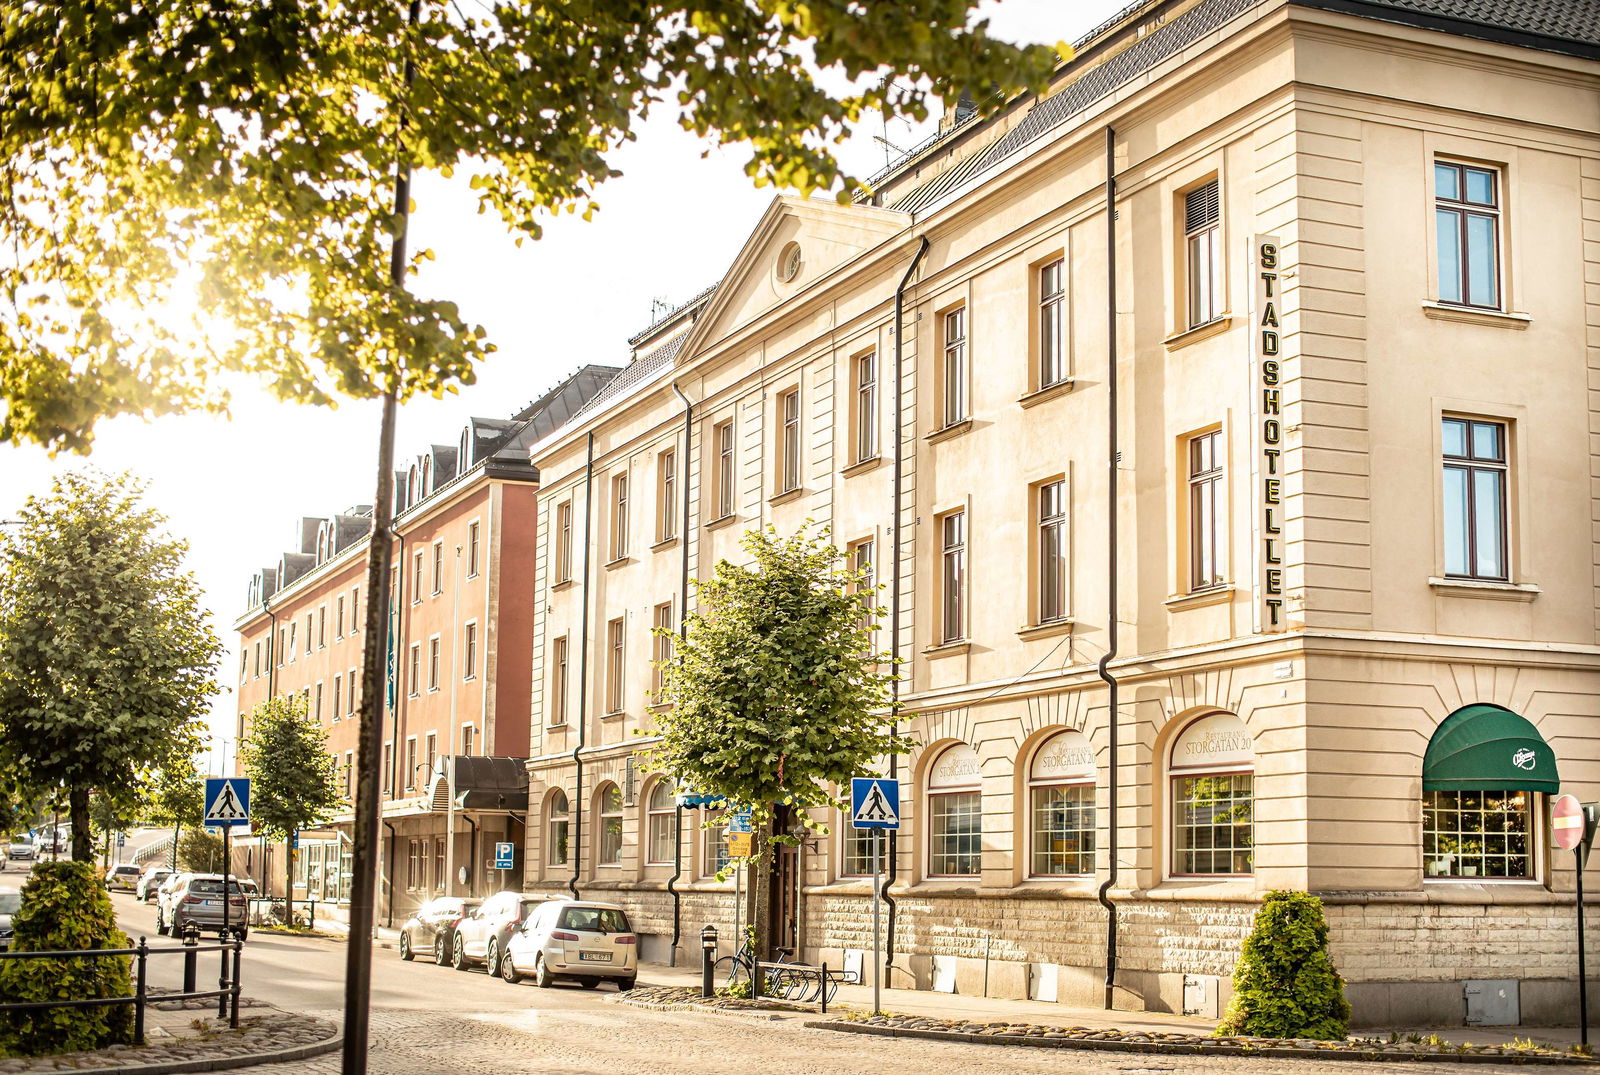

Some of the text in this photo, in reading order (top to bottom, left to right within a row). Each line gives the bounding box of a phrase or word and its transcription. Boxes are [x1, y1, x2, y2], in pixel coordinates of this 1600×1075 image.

[1260, 243, 1282, 625] STADSHOTELLET
[1185, 738, 1252, 754] STORGATAN 20
[1042, 752, 1086, 768] STORGATAN
[500, 844, 511, 859] P
